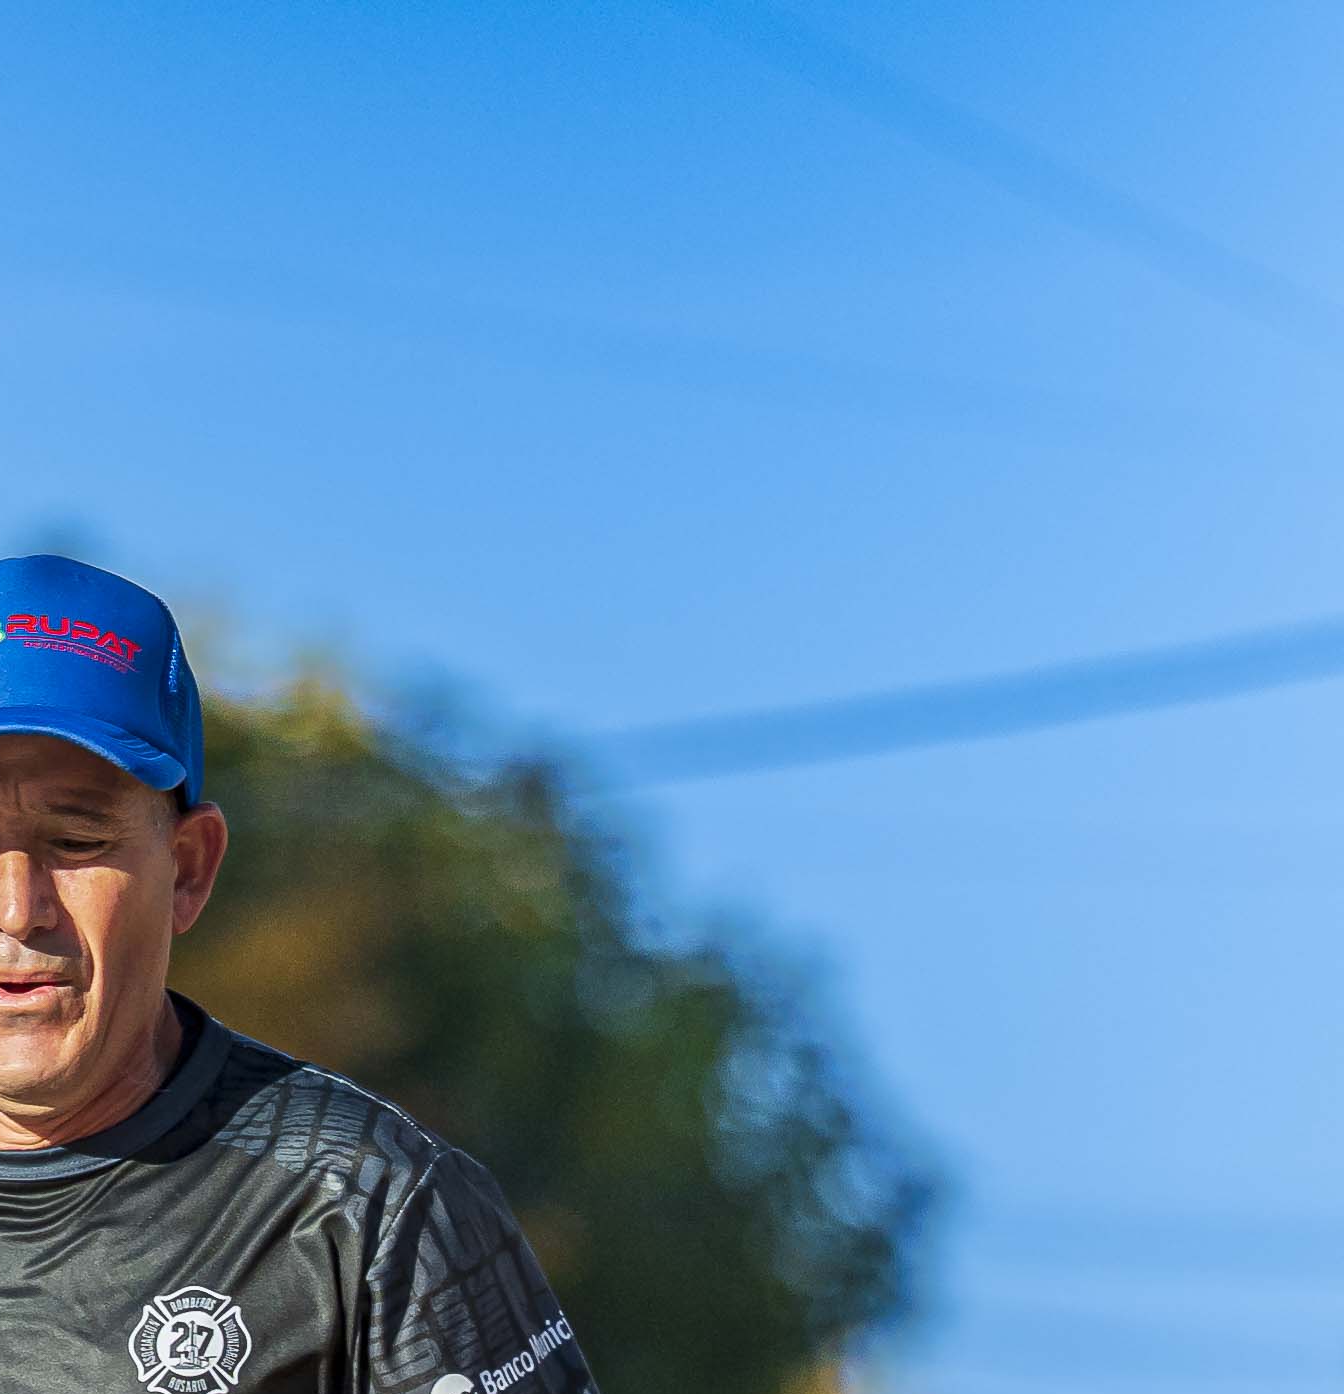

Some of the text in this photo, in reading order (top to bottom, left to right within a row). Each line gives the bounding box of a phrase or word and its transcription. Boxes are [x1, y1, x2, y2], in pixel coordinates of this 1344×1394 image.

[6, 614, 142, 662] RUPAT
[169, 1297, 217, 1313] BOMBEROS
[169, 1321, 214, 1359] 27
[167, 1377, 207, 1393] ROSARIO
